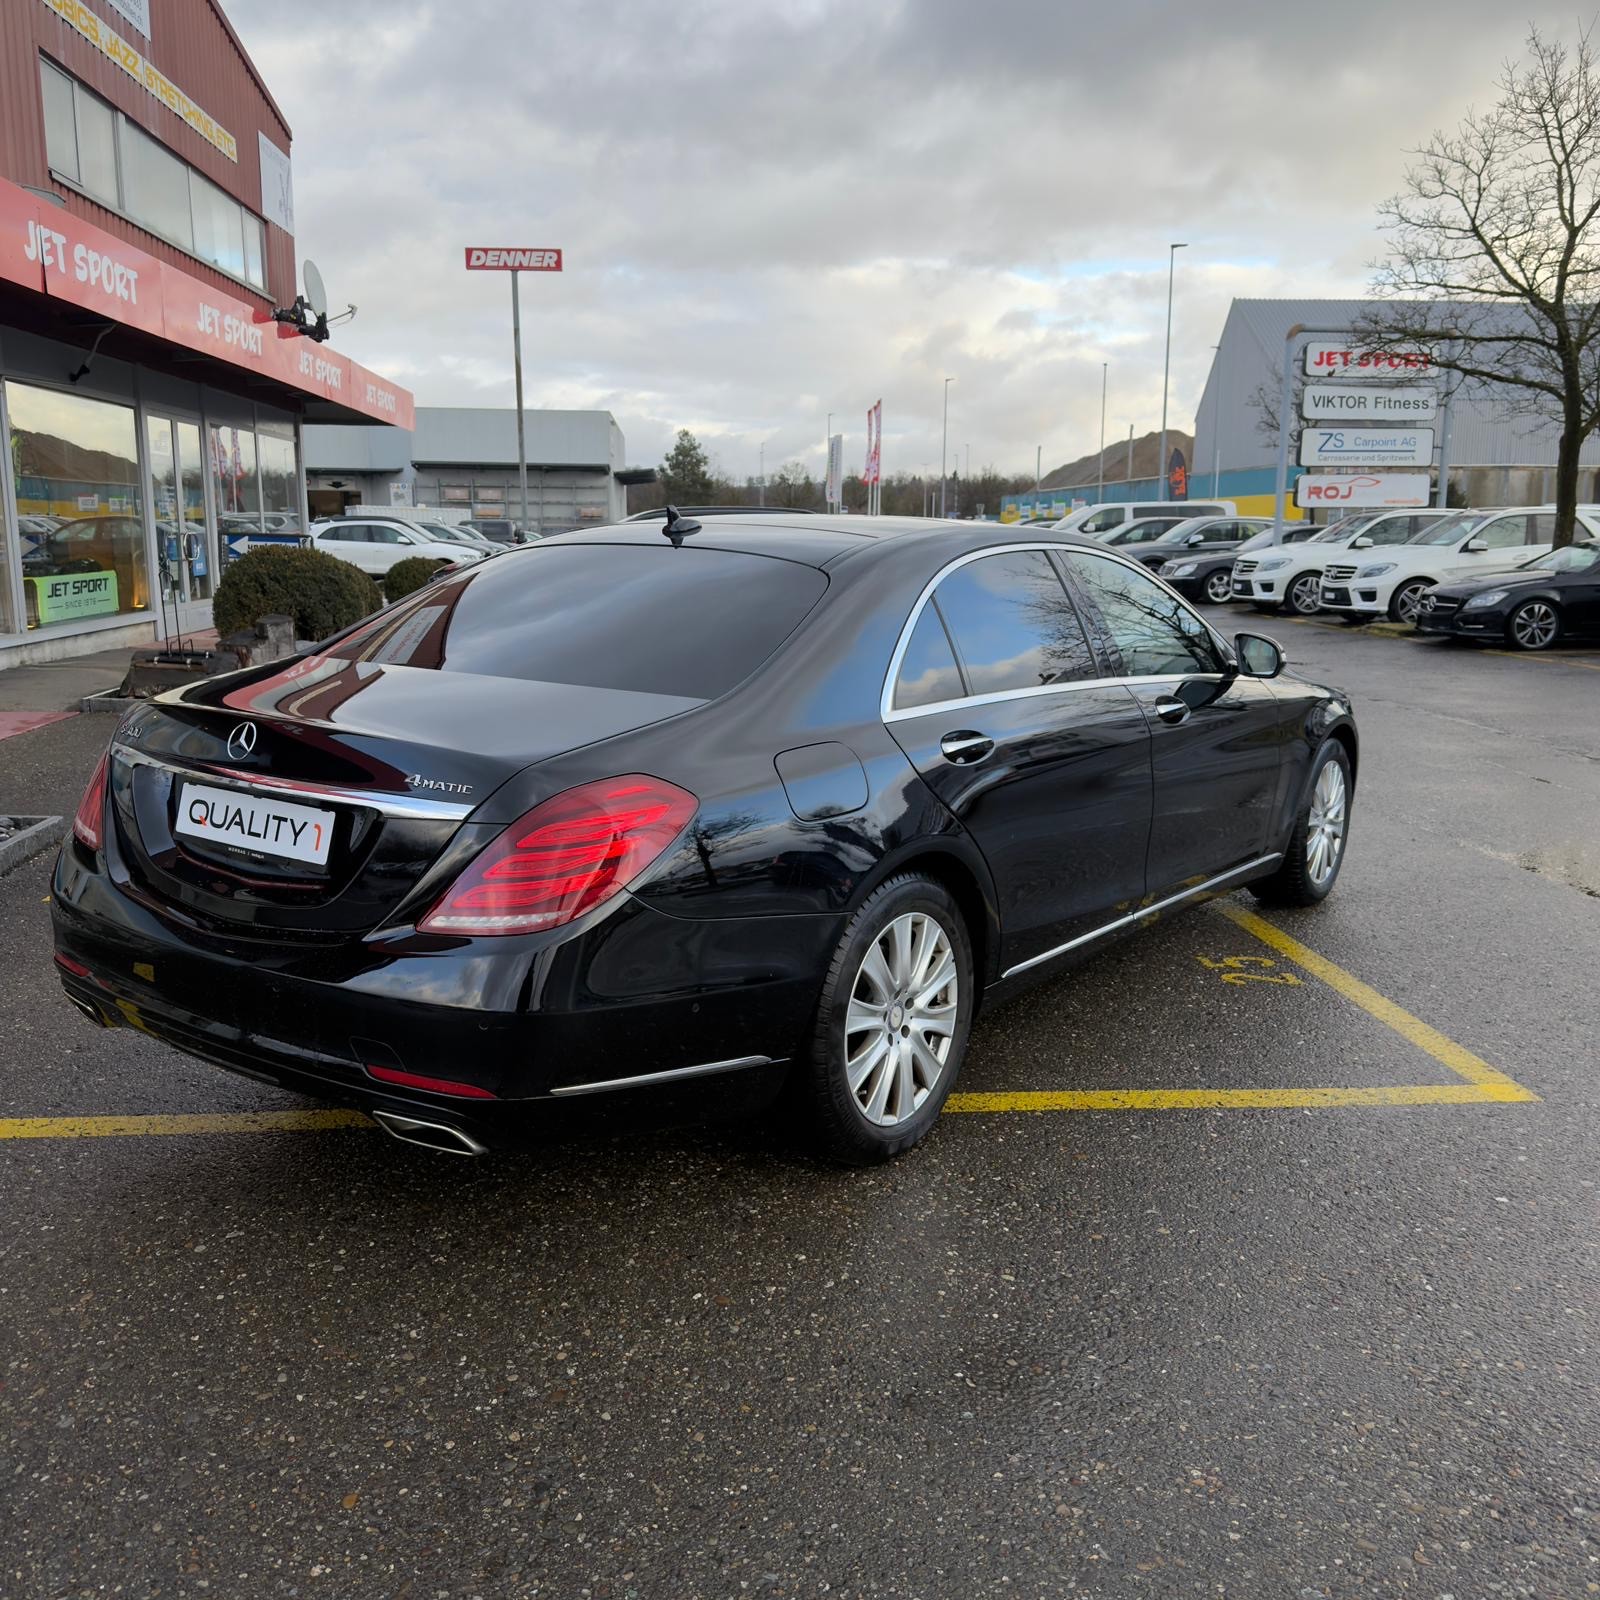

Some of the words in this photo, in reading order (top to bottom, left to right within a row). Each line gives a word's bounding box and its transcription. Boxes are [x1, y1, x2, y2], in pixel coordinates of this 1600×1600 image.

[24, 220, 66, 274] JET
[74, 244, 138, 304] SPORT
[470, 250, 558, 267] DENNER
[197, 303, 221, 338] JET
[224, 314, 263, 356] SPORT
[1313, 351, 1352, 367] JET
[299, 350, 313, 376] JET
[315, 358, 342, 389] SPORT
[366, 384, 377, 404] JET
[1312, 395, 1368, 409] VIKTOR
[1374, 396, 1430, 410] Fitness
[1354, 437, 1397, 449] Carpoint
[1400, 437, 1417, 447] AG
[1361, 454, 1376, 462] und
[1377, 454, 1416, 463] Spritzwerk
[1307, 485, 1353, 500] ROJ
[47, 582, 70, 598] JET
[72, 578, 109, 595] SPORT
[404, 773, 473, 795] 4MATIC
